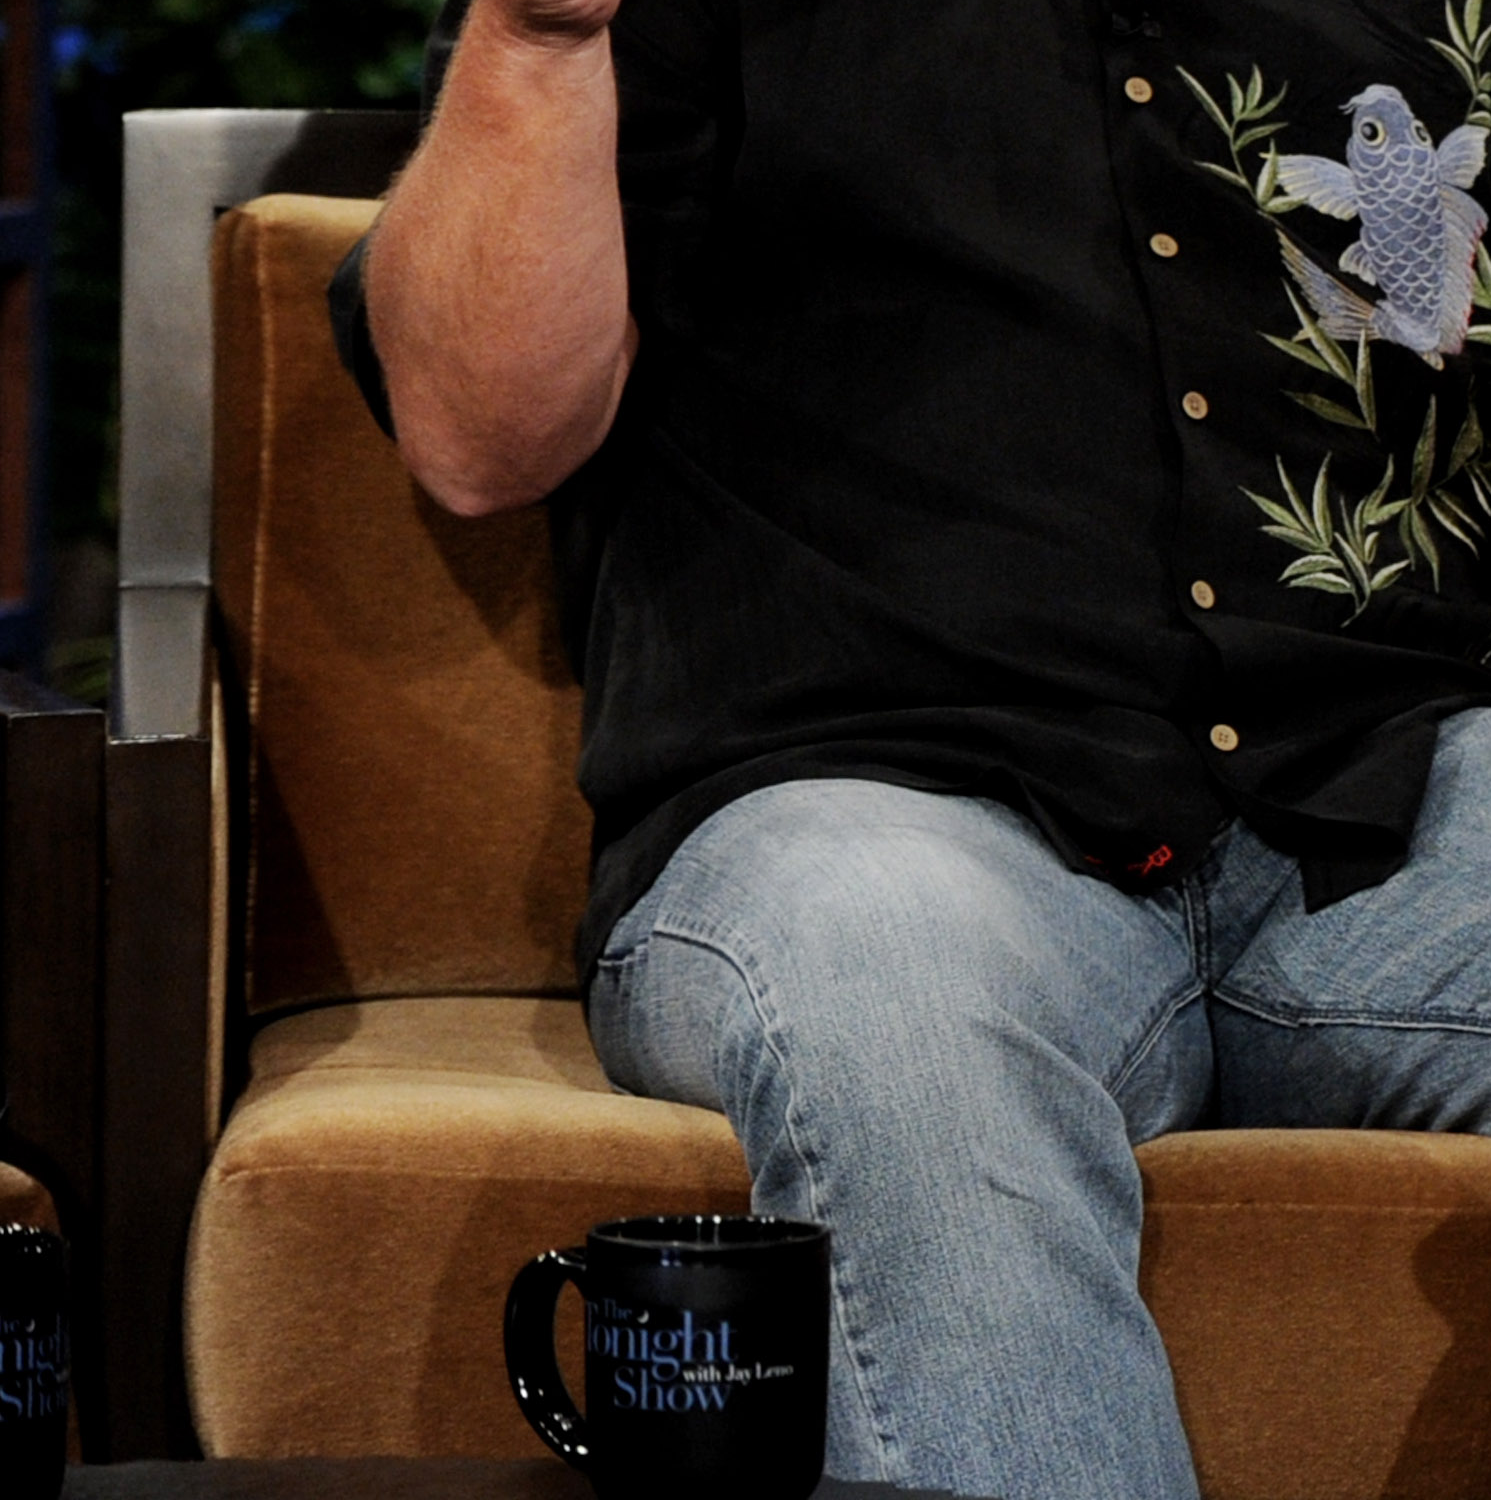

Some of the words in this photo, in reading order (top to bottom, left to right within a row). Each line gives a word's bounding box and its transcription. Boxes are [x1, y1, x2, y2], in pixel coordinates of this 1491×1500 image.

[602, 1298, 632, 1320] The
[586, 1300, 739, 1382] Tonight
[613, 1366, 732, 1413] Show
[682, 1364, 722, 1383] with
[725, 1363, 753, 1386] Jay
[755, 1361, 794, 1380] Leno
